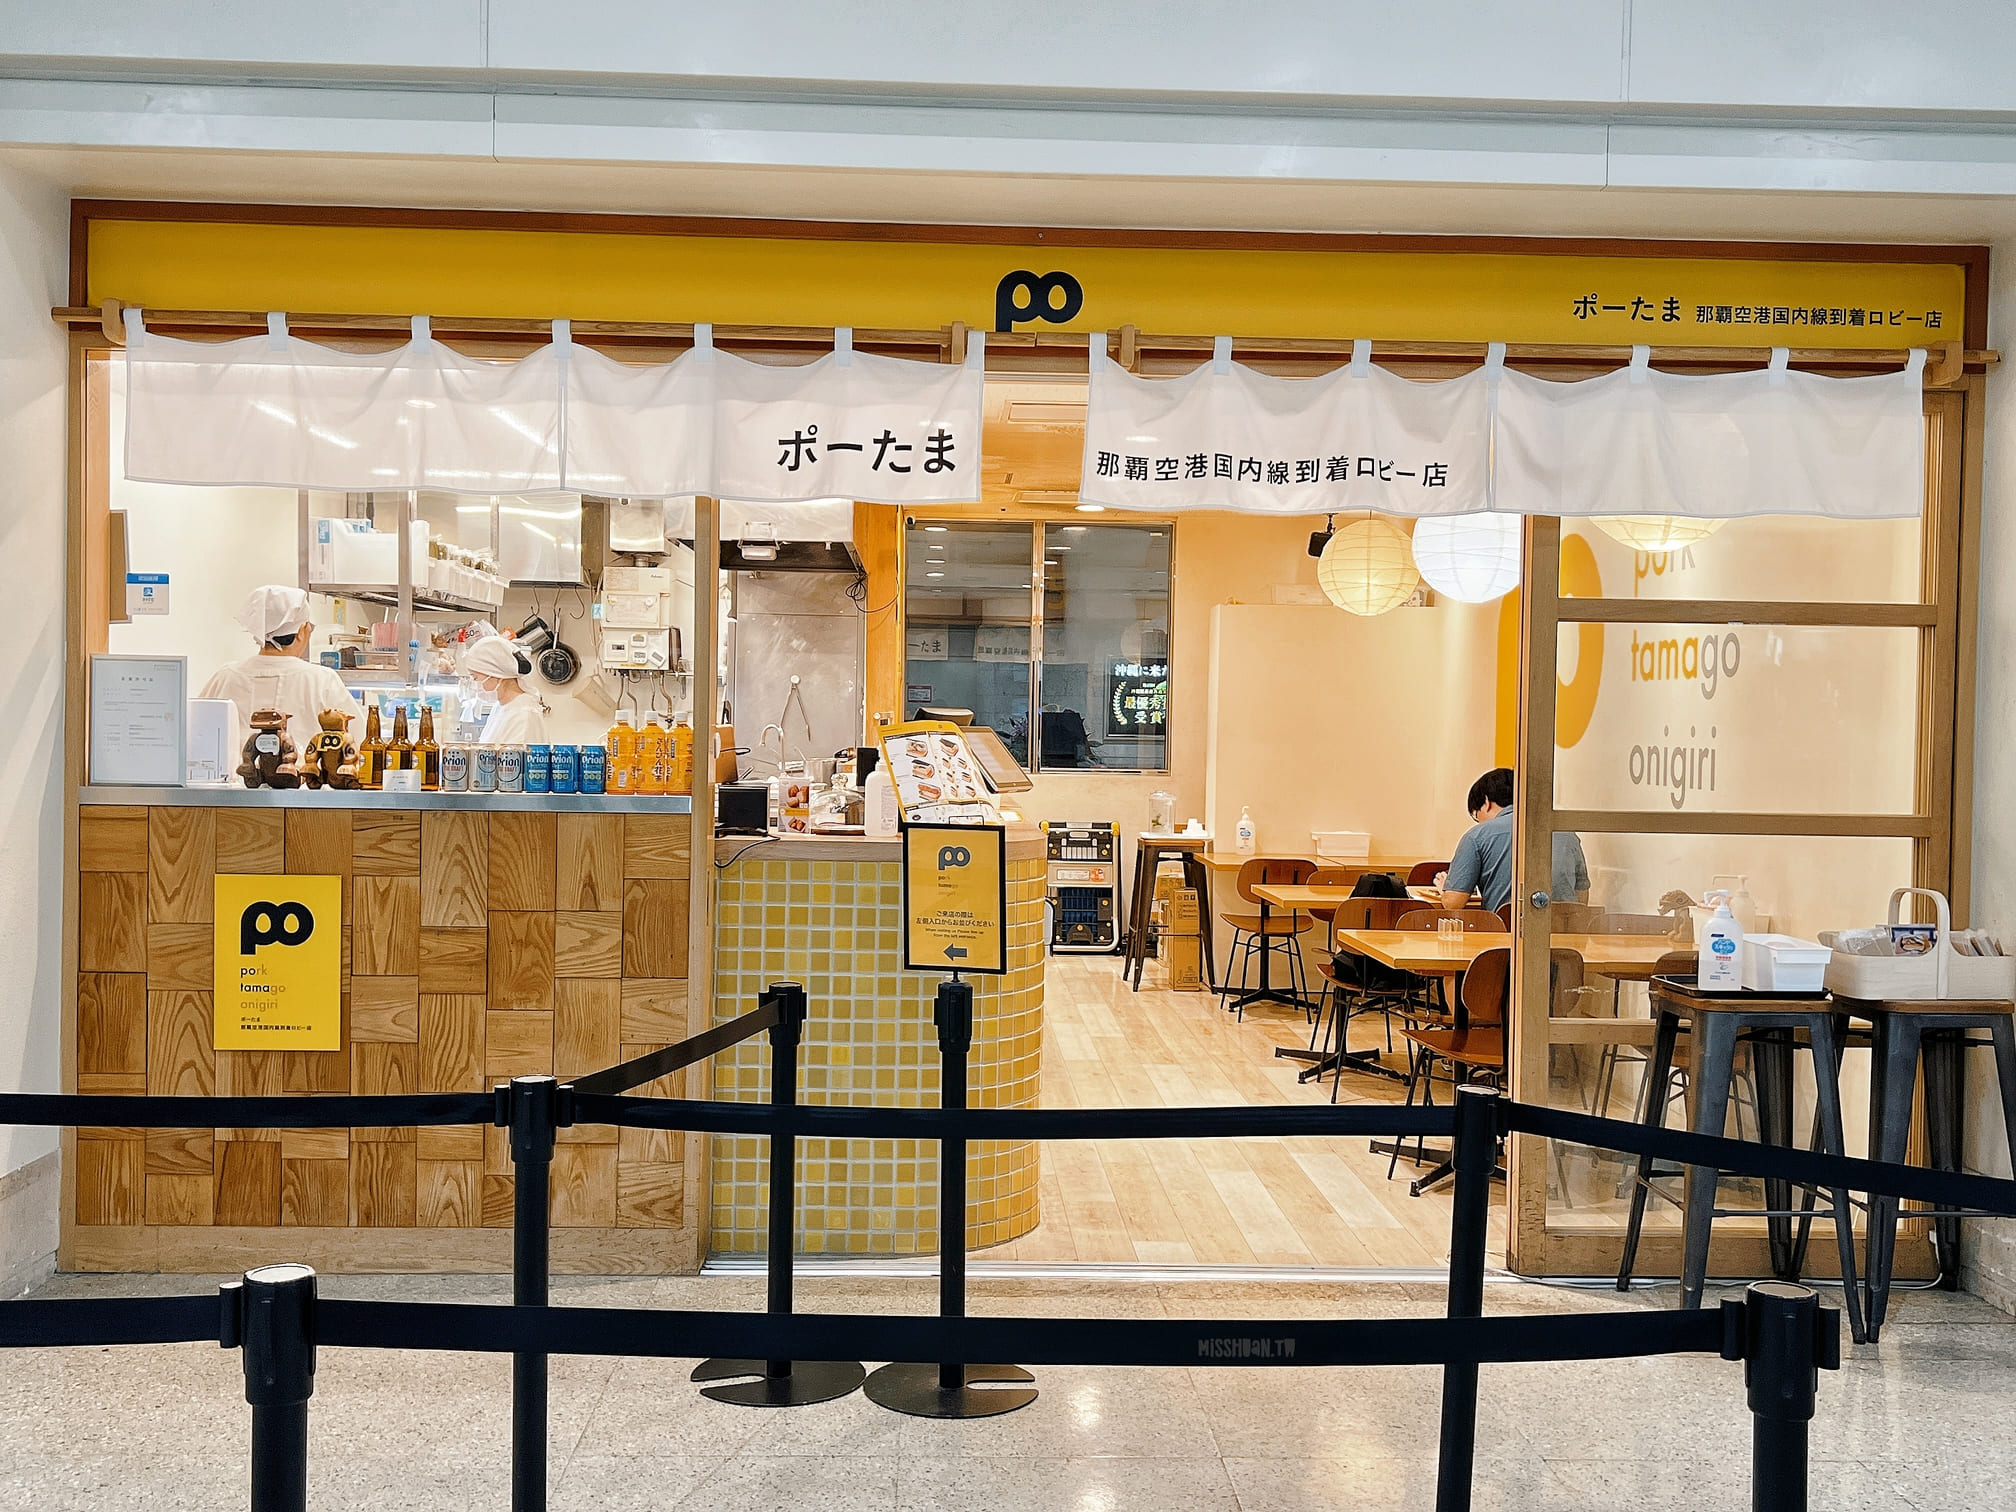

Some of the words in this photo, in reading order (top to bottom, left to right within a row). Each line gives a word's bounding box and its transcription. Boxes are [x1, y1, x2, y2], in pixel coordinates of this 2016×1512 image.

[995, 269, 1084, 333] po
[1572, 292, 1682, 323] ポーたま
[1695, 305, 1943, 329] 那覇空港国内線到着ロビー店
[777, 424, 956, 474] ポーたま
[1096, 450, 1449, 488] 那覇空港国内線到着ロビー店
[1631, 629, 1741, 701] tamago
[1629, 725, 1717, 810] onigiri
[937, 846, 971, 871] po
[240, 901, 315, 955] po
[240, 964, 268, 978] pork
[240, 982, 286, 996] tamago
[240, 998, 279, 1012] onigiri
